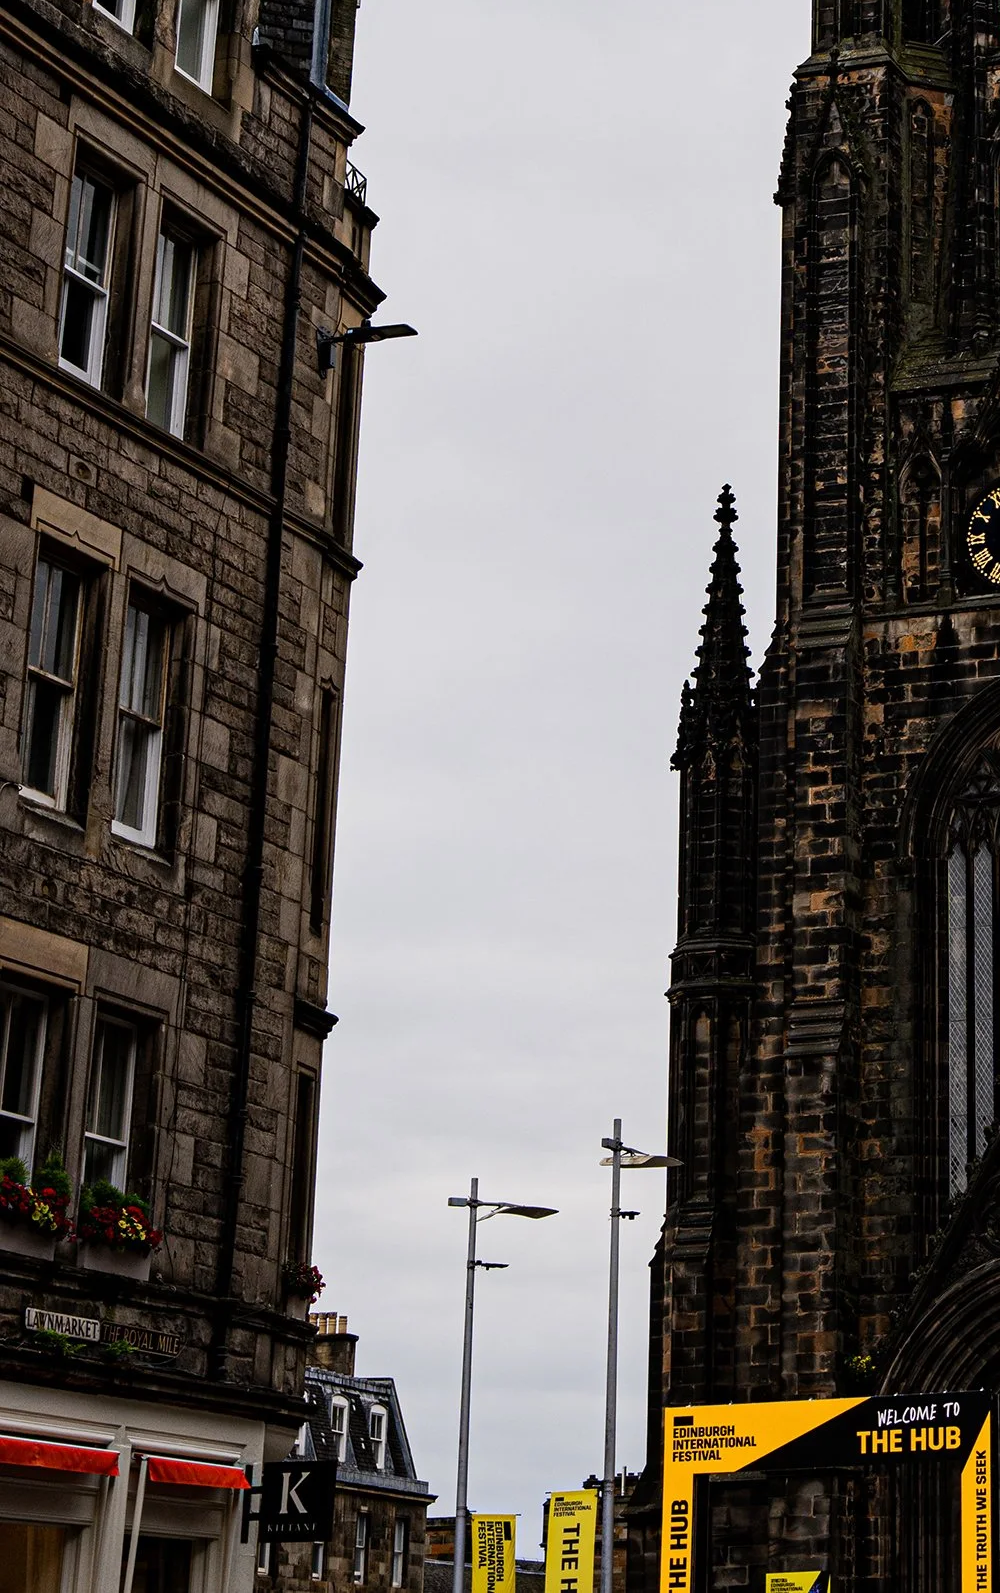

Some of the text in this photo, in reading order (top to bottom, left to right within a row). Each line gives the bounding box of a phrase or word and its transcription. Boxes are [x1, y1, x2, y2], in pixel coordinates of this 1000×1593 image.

[26, 1308, 99, 1339] LAWNMARKET
[103, 1323, 180, 1355] THE ROYAL MILE
[877, 1402, 960, 1427] WELCOME TO
[673, 1425, 735, 1439] EDINBURGH
[673, 1436, 757, 1450] INTERNATIONAL
[856, 1426, 961, 1454] THE HUB
[672, 1450, 722, 1462] FESTIVAL
[279, 1471, 310, 1514] K
[975, 1450, 987, 1592] THE TRUTH WE SEEK
[478, 1521, 487, 1569] FESTIVAL
[495, 1521, 504, 1582] EDINBURGH
[561, 1523, 580, 1571] THE
[669, 1499, 689, 1593] HE HUB
